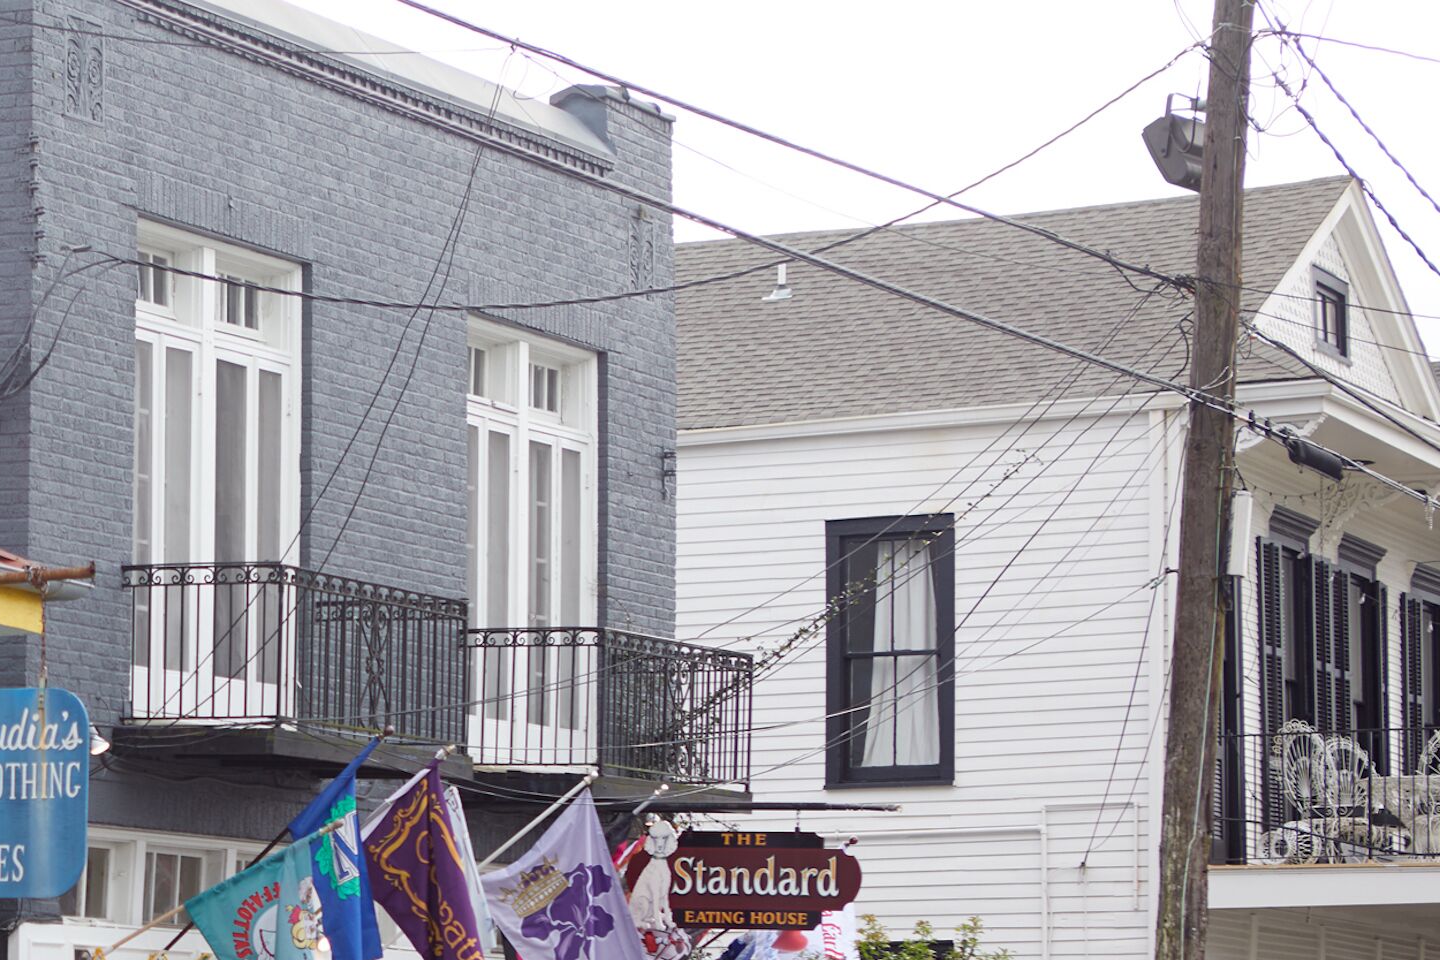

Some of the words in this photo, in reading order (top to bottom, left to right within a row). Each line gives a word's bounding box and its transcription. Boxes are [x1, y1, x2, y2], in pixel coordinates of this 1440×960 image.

[721, 832, 768, 846] THE
[671, 855, 840, 897] Standard
[684, 911, 745, 924] EATING
[750, 912, 809, 926] HOUSE
